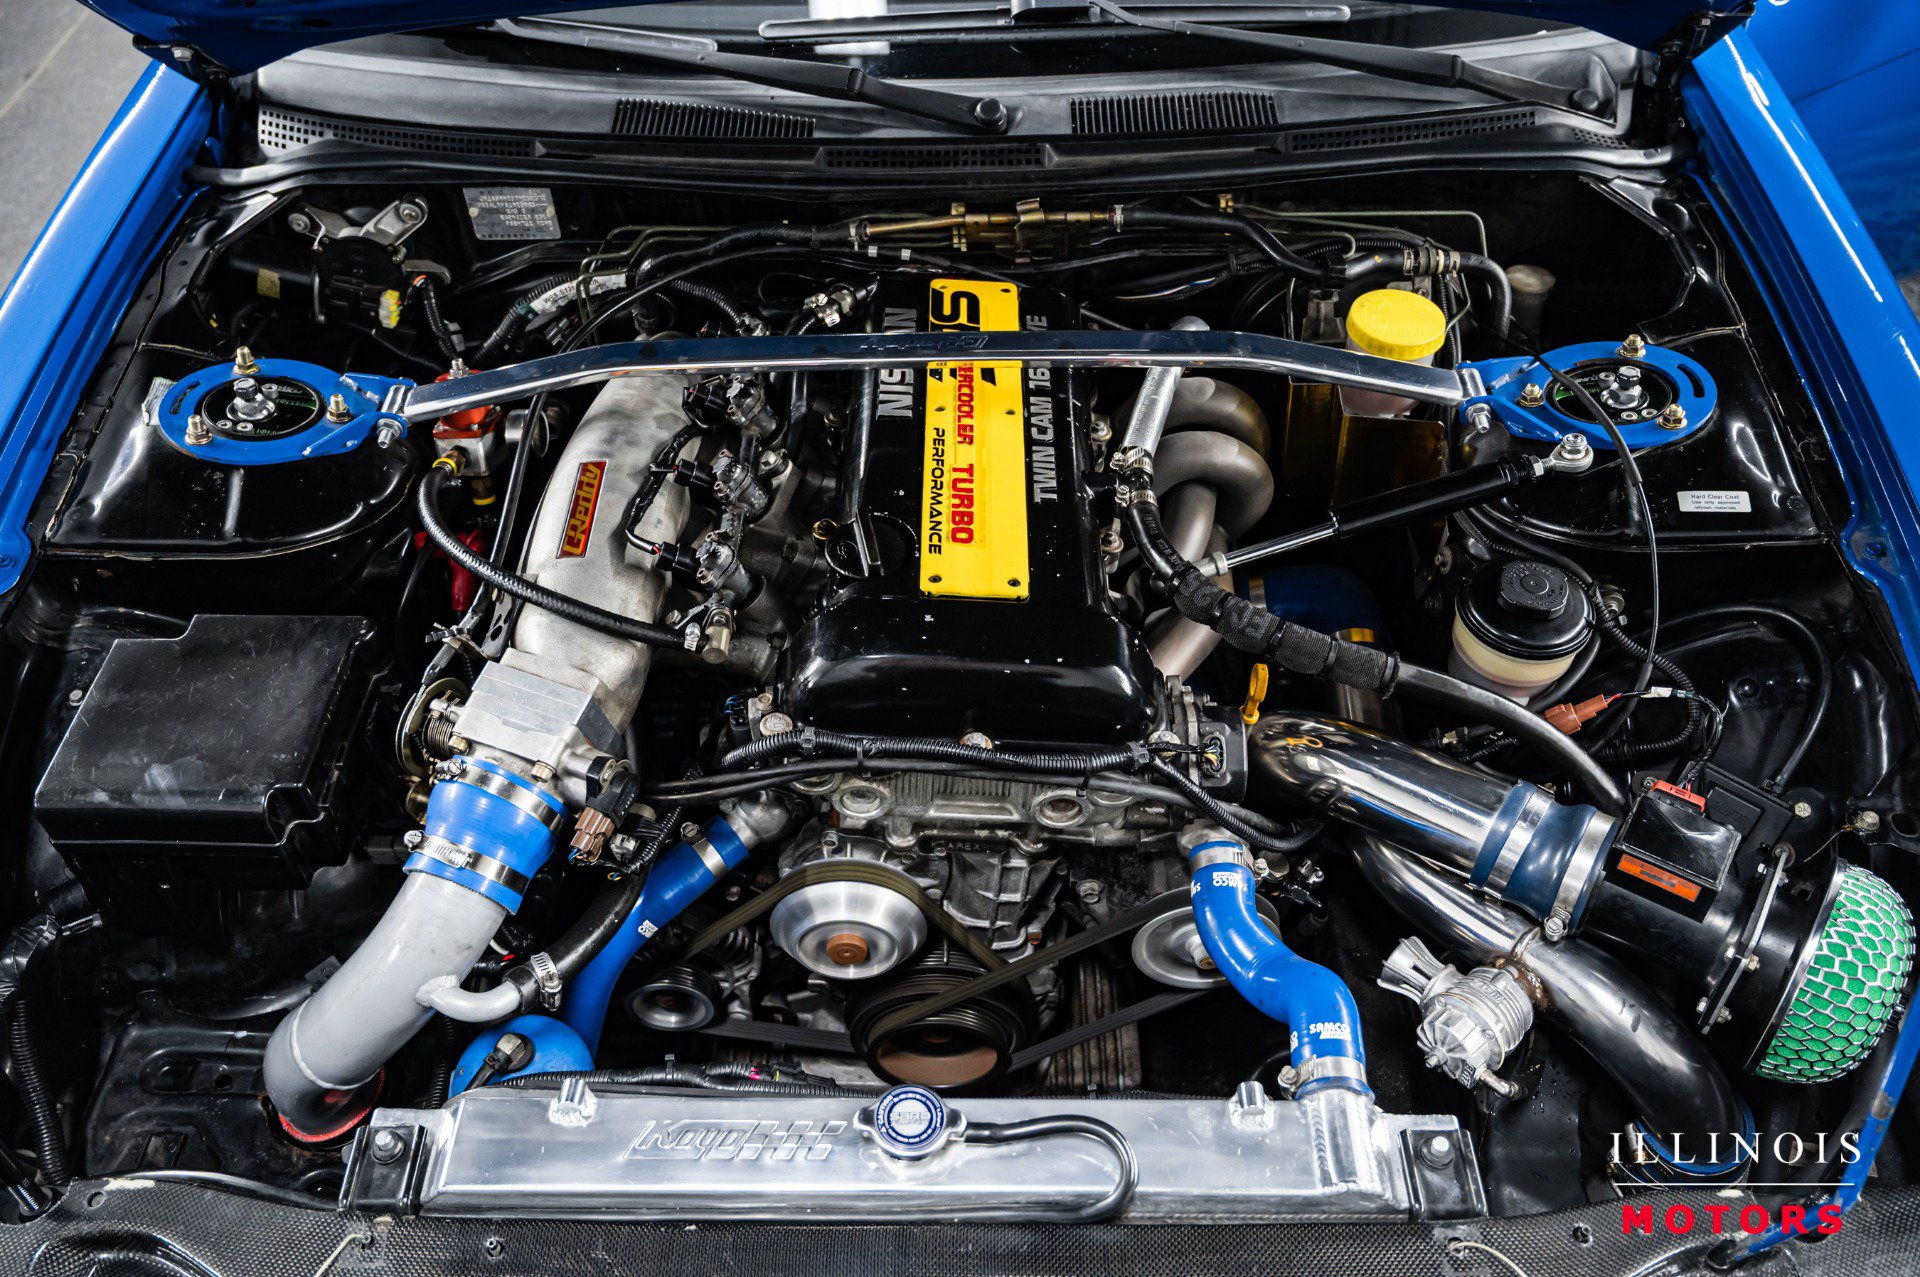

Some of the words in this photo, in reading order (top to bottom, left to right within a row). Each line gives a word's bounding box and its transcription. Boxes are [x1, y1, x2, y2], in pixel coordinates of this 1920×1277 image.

[1030, 396, 1054, 442] CAM
[928, 427, 945, 555] PERFORMANCE
[1032, 446, 1058, 504] TWIN
[950, 463, 975, 544] TURBO
[1213, 878, 1248, 892] SAMCO
[1309, 1022, 1351, 1034] SAMCO
